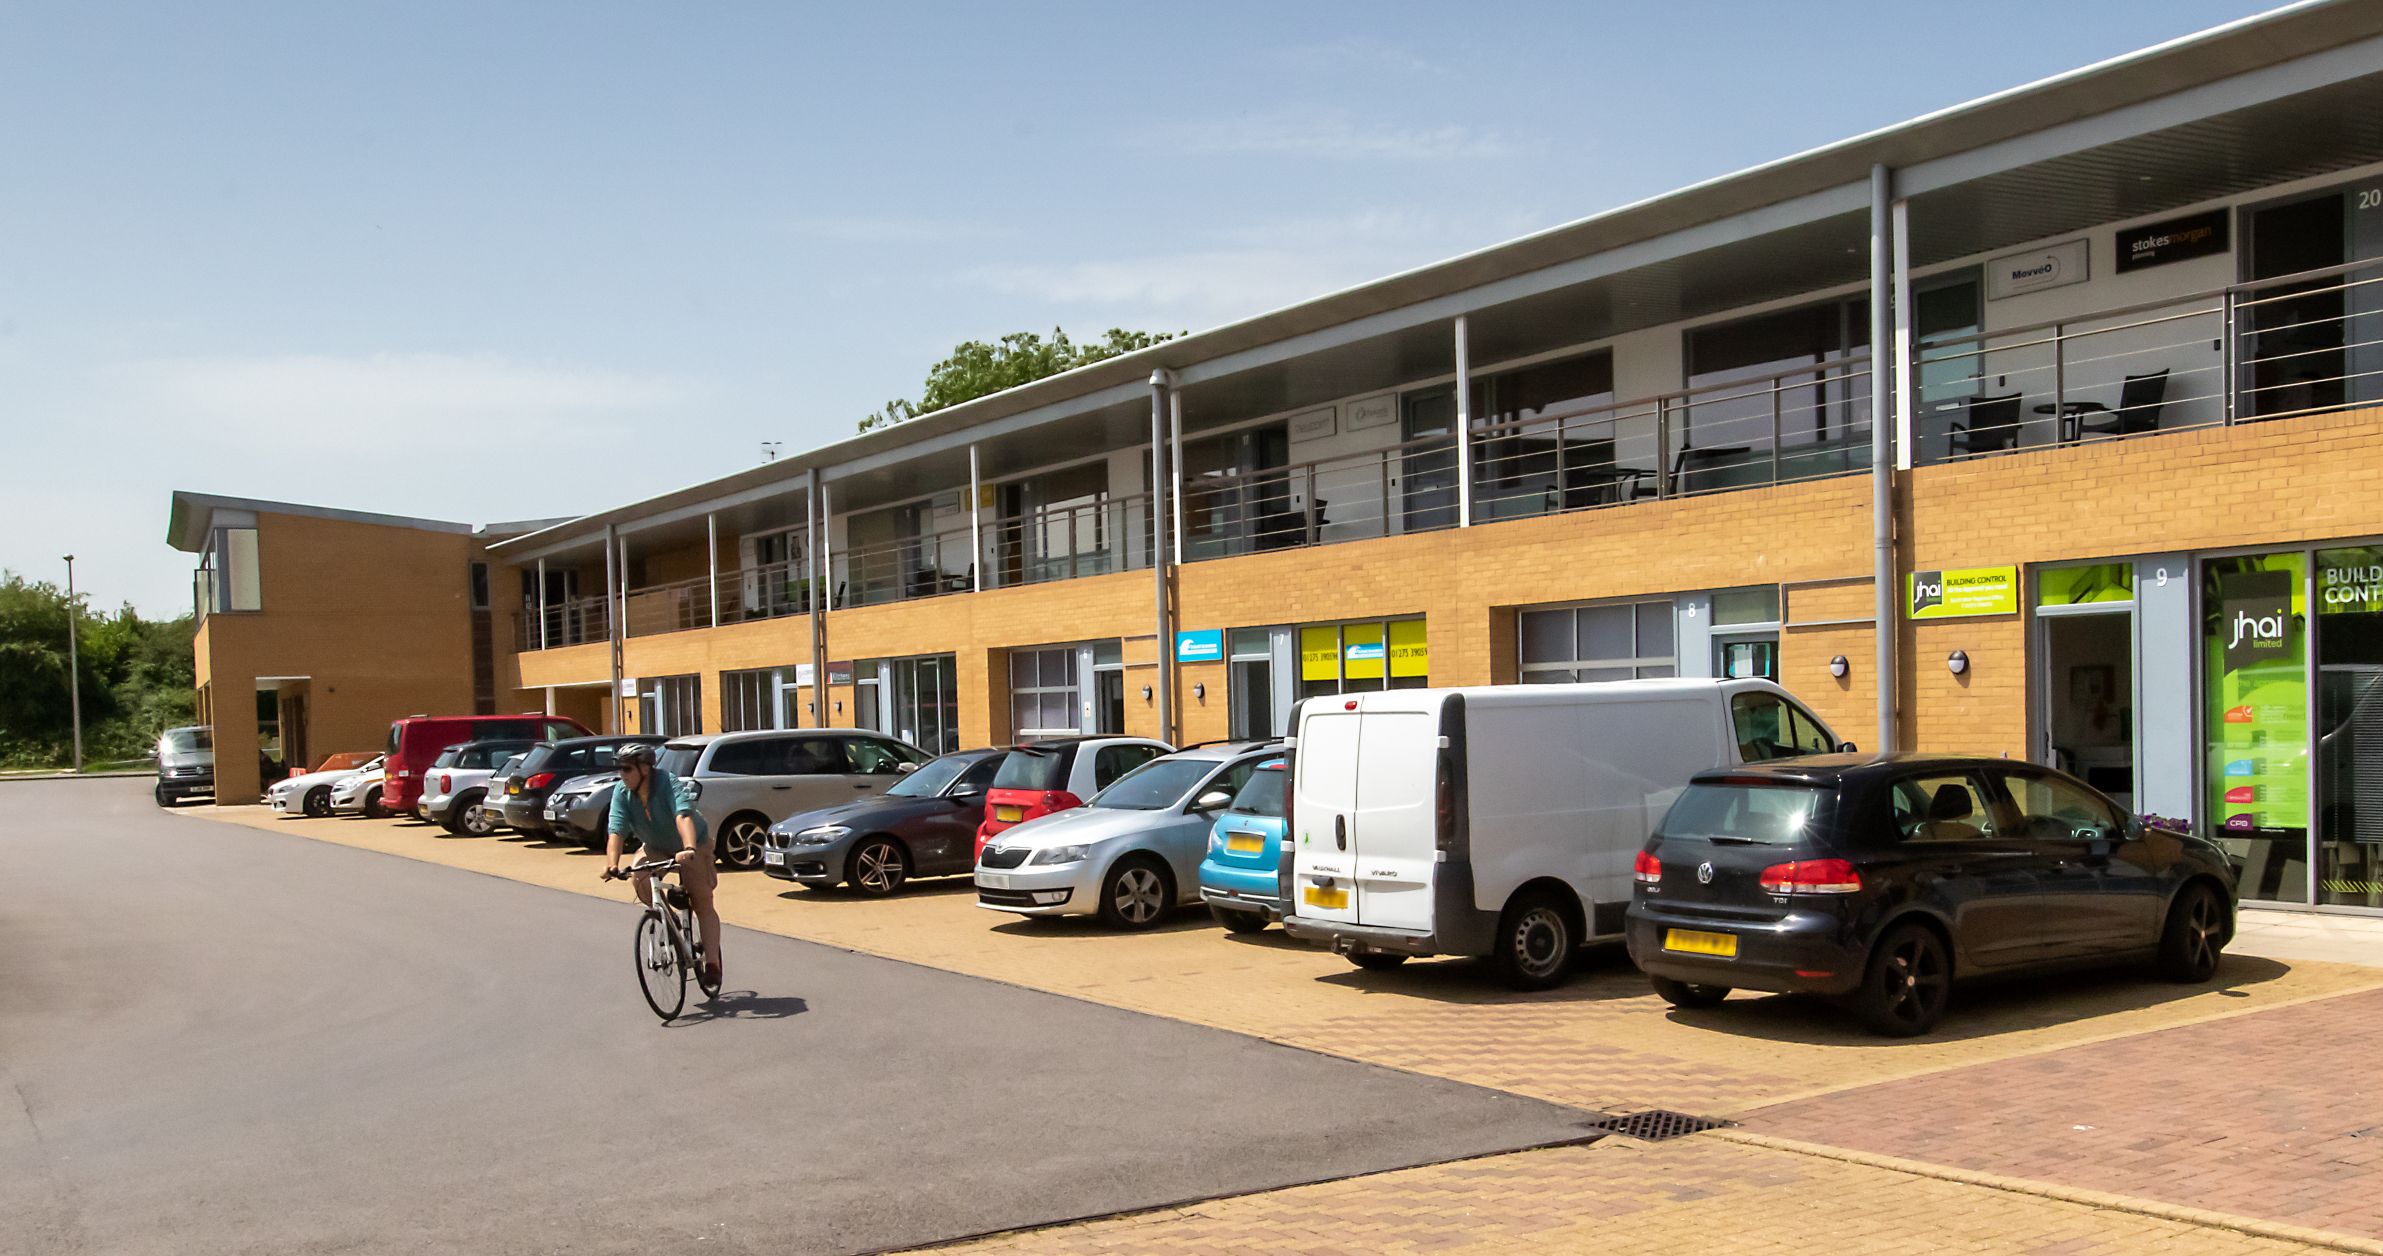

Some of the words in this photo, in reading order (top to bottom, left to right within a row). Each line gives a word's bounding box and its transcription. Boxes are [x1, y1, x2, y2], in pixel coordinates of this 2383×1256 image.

[2359, 189, 2381, 209] 20
[1977, 575, 2007, 584] CONTROL
[2156, 568, 2168, 587] 9
[1914, 580, 1941, 603] jhai
[1688, 602, 1696, 618] 8
[2228, 608, 2283, 650] jhai
[2253, 639, 2283, 649] limited
[1391, 648, 1409, 658] 01275
